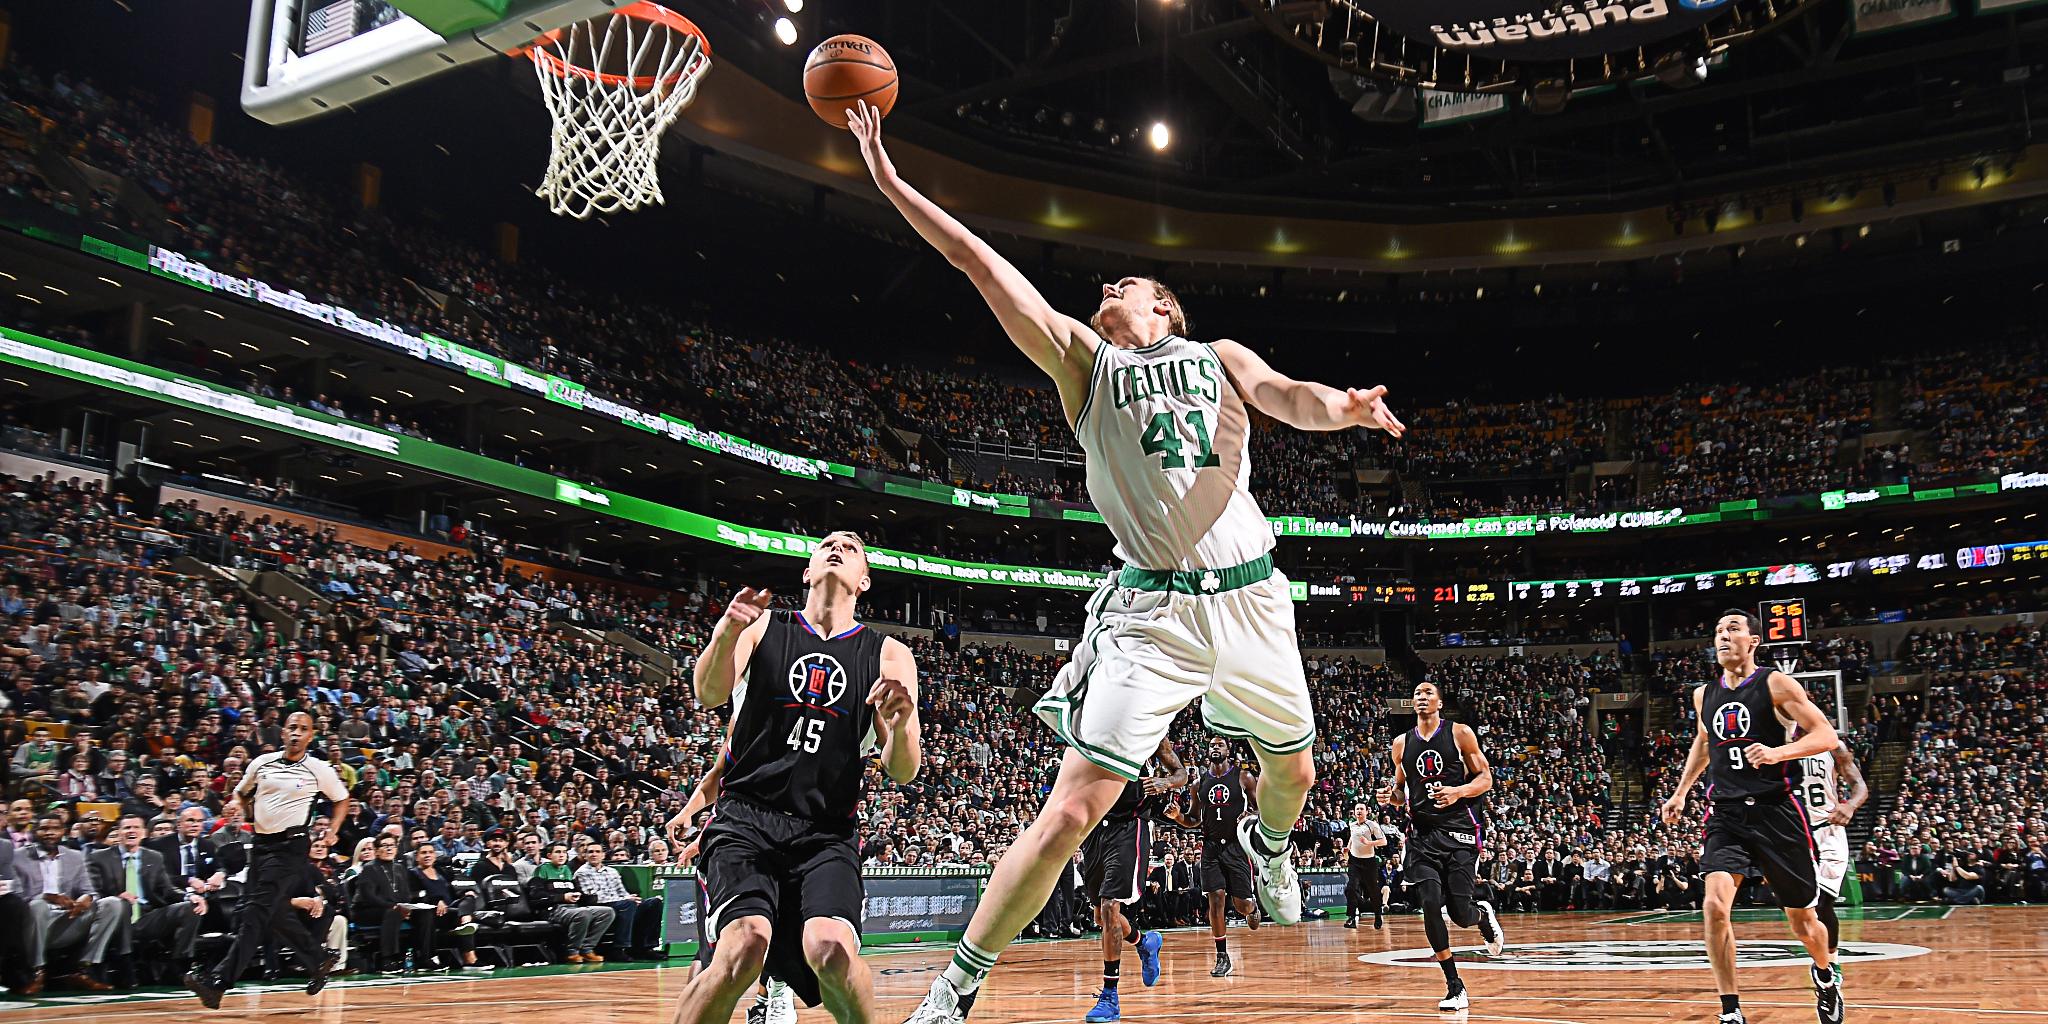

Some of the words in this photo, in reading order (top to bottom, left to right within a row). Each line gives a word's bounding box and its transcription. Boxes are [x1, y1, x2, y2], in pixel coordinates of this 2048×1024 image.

[1437, 0, 1669, 46] Putnam
[1113, 358, 1217, 409] CELTICS
[1140, 410, 1220, 470] 41
[1350, 519, 1385, 535] New
[1389, 520, 1470, 536] Customers
[1474, 521, 1502, 534] can
[1505, 518, 1533, 536] get
[1535, 519, 1547, 532] a
[953, 566, 989, 580] more
[991, 570, 1007, 581] or
[1010, 569, 1040, 583] visit
[1826, 561, 1855, 578] 37
[1917, 554, 1948, 570] 41
[1310, 585, 1341, 595] Bank
[1352, 593, 1362, 601] 37
[1434, 587, 1454, 601] 21
[1519, 590, 1527, 599] 6
[1568, 589, 1576, 597] 2
[1594, 588, 1602, 596] 1
[1769, 618, 1801, 639] 21
[787, 716, 825, 753] 45
[1728, 747, 1743, 769] 9
[1425, 781, 1442, 799] 3
[1216, 808, 1222, 820] 1
